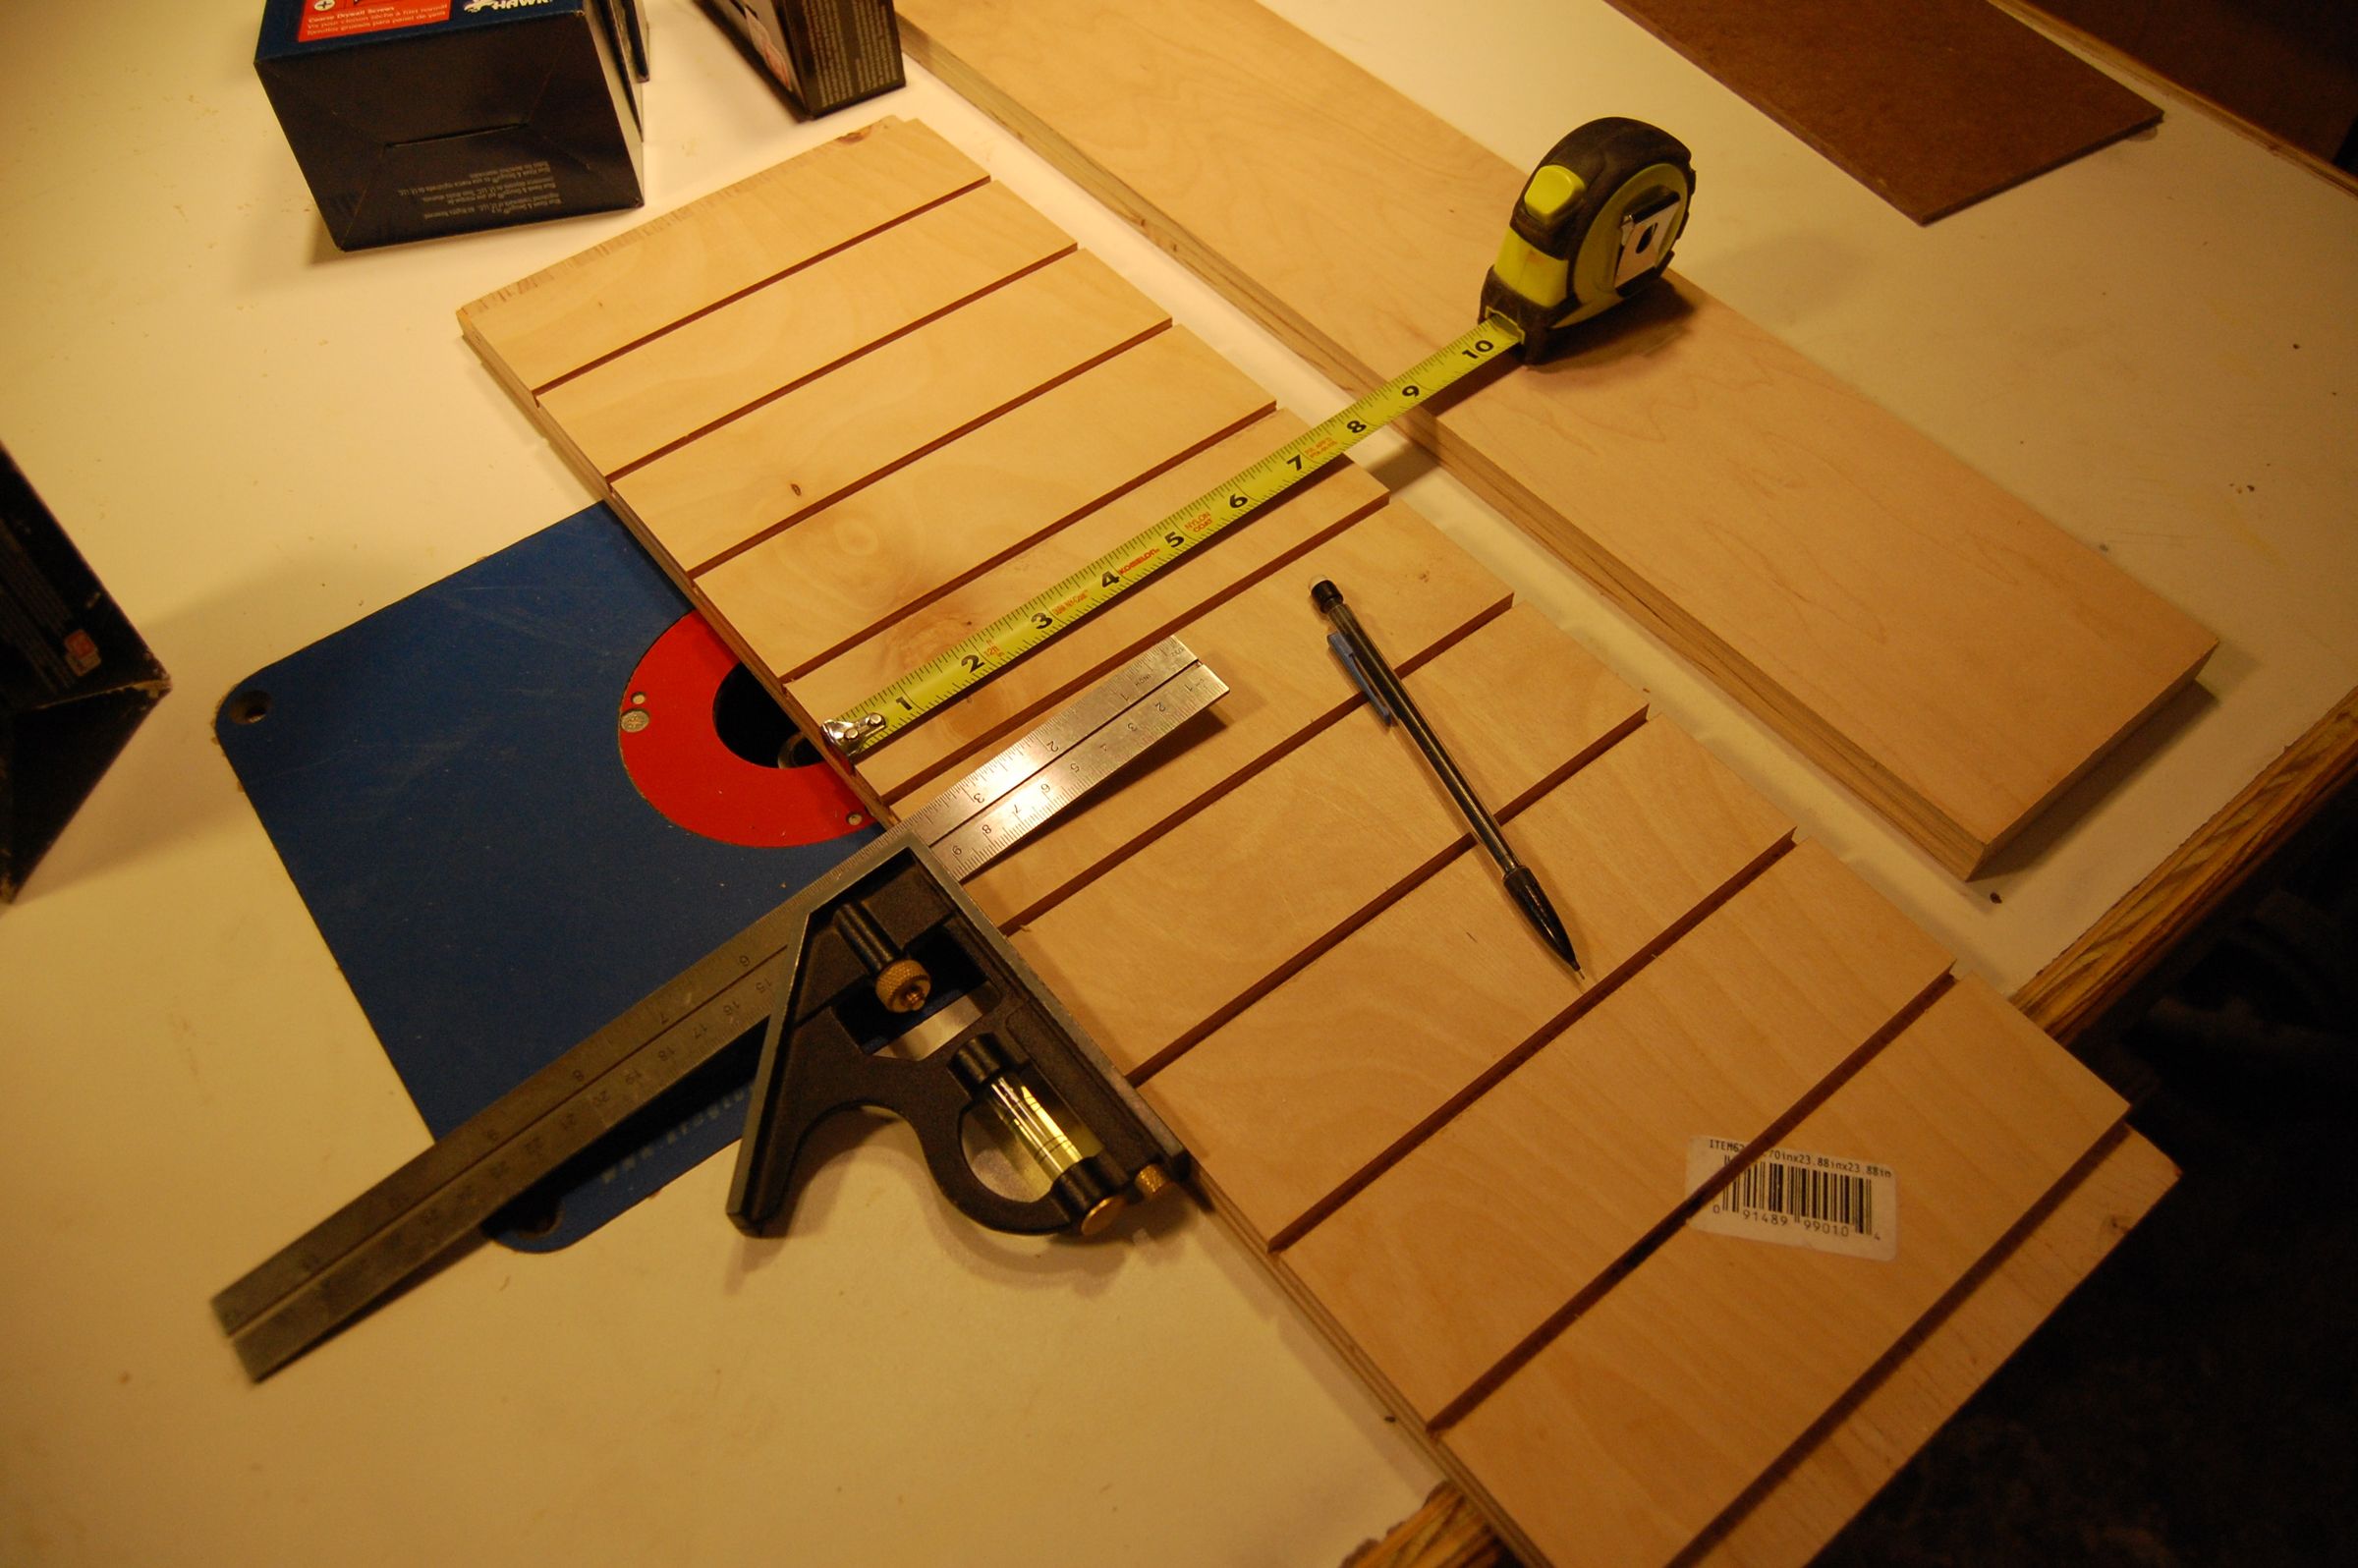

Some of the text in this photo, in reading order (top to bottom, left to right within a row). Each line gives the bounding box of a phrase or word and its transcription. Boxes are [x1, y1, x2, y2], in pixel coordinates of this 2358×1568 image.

[895, 697, 913, 710] 1
[961, 654, 984, 673] 2
[1031, 612, 1053, 630] 3
[1101, 570, 1120, 588] 4
[1164, 531, 1185, 548] 5
[1229, 493, 1248, 509] 6
[1286, 454, 1303, 472] 7
[1346, 420, 1367, 433] 8
[1401, 385, 1420, 398] 9
[1461, 340, 1494, 360] 10
[1184, 512, 1211, 531] NYLON
[1155, 701, 1167, 712] 2
[1127, 722, 1138, 732] 3
[1046, 740, 1059, 753] 2
[1070, 762, 1080, 773] 5
[1040, 783, 1051, 793] 6
[974, 792, 985, 804] 3
[982, 824, 992, 835] 8
[951, 845, 963, 856] 9
[1712, 1205, 1881, 1241] 0 91489 99010 4
